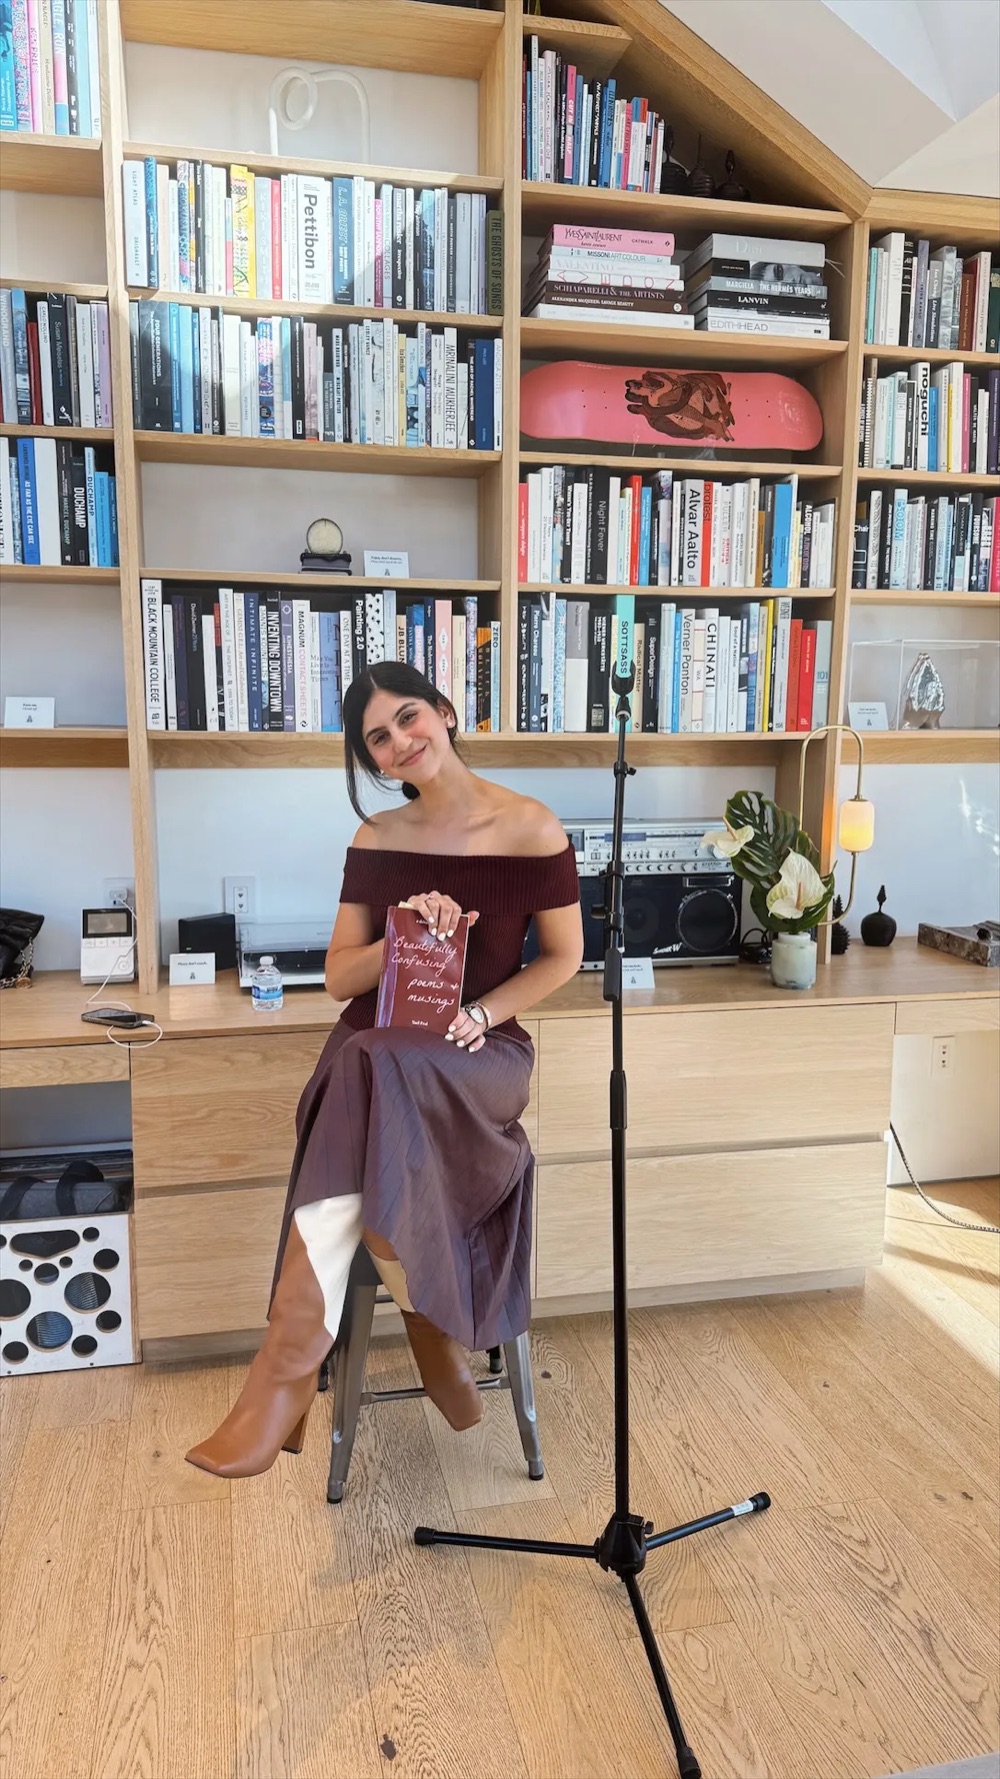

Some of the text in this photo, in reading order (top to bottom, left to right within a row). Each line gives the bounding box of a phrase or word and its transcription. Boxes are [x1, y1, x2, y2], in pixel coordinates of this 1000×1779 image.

[568, 114, 573, 123] IN
[304, 194, 318, 269] Pettibon
[492, 217, 501, 309] THE GHOSTS OF SONGS
[554, 284, 608, 295] SCHIAPARELLI
[633, 291, 664, 299] ARTISTS
[726, 281, 754, 290] MARGIELA
[760, 283, 770, 292] THE
[794, 287, 812, 295] YEARS
[738, 296, 768, 304] LANVIN
[0, 294, 10, 347] WINOGRAND
[446, 344, 455, 431] MRINALINI MUKHERJEE
[920, 367, 928, 435] noguchi
[74, 487, 86, 528] DUCHAMP
[597, 500, 606, 525] Night
[703, 484, 712, 522] protest
[804, 505, 813, 534] ALCOHOL
[687, 489, 700, 568] Alvar Aalto
[894, 501, 905, 541] BOOM
[972, 515, 981, 544] FOURSOME
[355, 600, 364, 634] Painting
[399, 626, 404, 636] JB
[148, 597, 160, 702] BLACK MOUNTAIN COLLEGE
[268, 612, 282, 712] INVENTING DOWNTOWN
[648, 637, 656, 677] SuperDesign
[681, 614, 692, 695] Verner Panton
[706, 623, 717, 688] CHINATI
[696, 670, 701, 680] WA
[817, 671, 828, 680] 101
[391, 952, 447, 977] Confusing
[394, 935, 457, 963] Beautifully
[407, 978, 444, 989] poems
[407, 994, 455, 1014] musings
